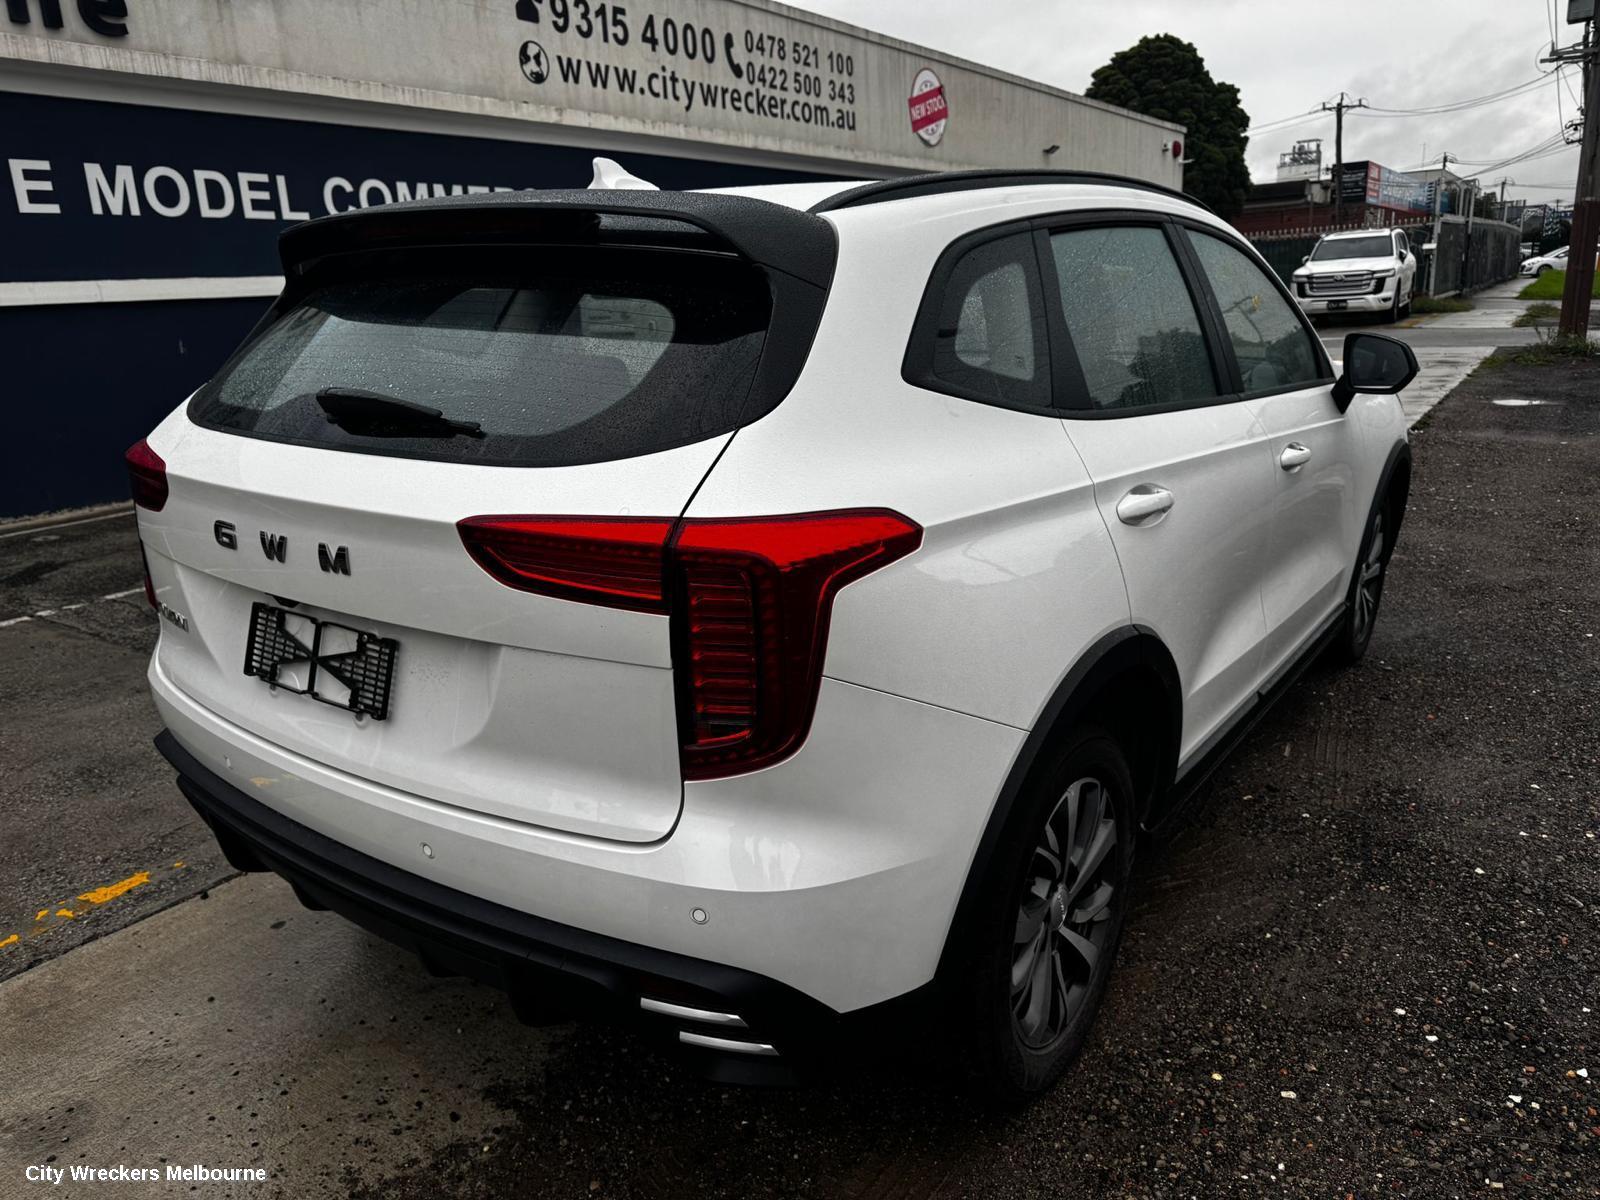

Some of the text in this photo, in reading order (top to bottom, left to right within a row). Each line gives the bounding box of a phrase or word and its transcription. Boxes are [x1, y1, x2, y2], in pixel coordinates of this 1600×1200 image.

[551, 0, 715, 64] 9315 4000
[744, 30, 854, 77] 0478 521 100
[556, 55, 856, 131] www.citywrecker.com.au
[746, 61, 855, 105] 0422 500 343
[8, 158, 61, 214] E
[83, 162, 310, 220] MODEL
